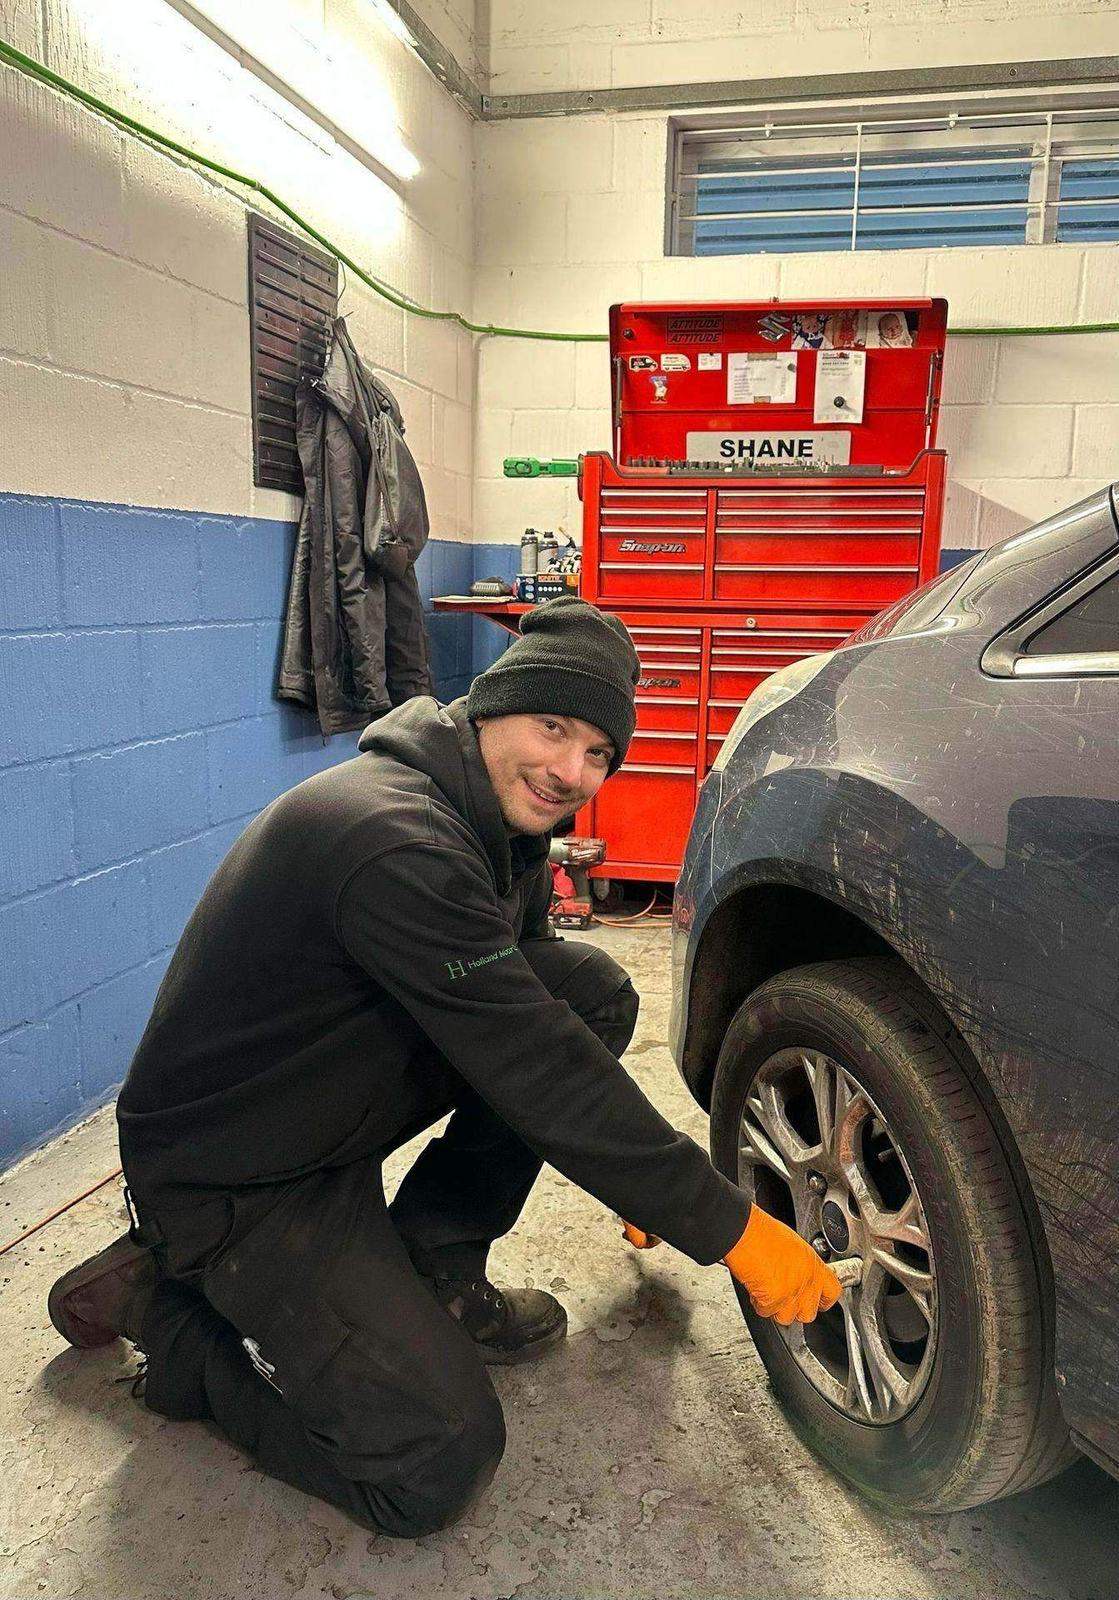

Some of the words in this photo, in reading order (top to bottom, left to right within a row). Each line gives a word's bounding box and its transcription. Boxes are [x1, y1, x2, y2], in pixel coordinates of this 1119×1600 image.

[669, 318, 721, 330] ATTITUDE
[669, 333, 720, 344] ATTITUDE
[720, 439, 813, 458] SHANE
[467, 951, 499, 969] Holland
